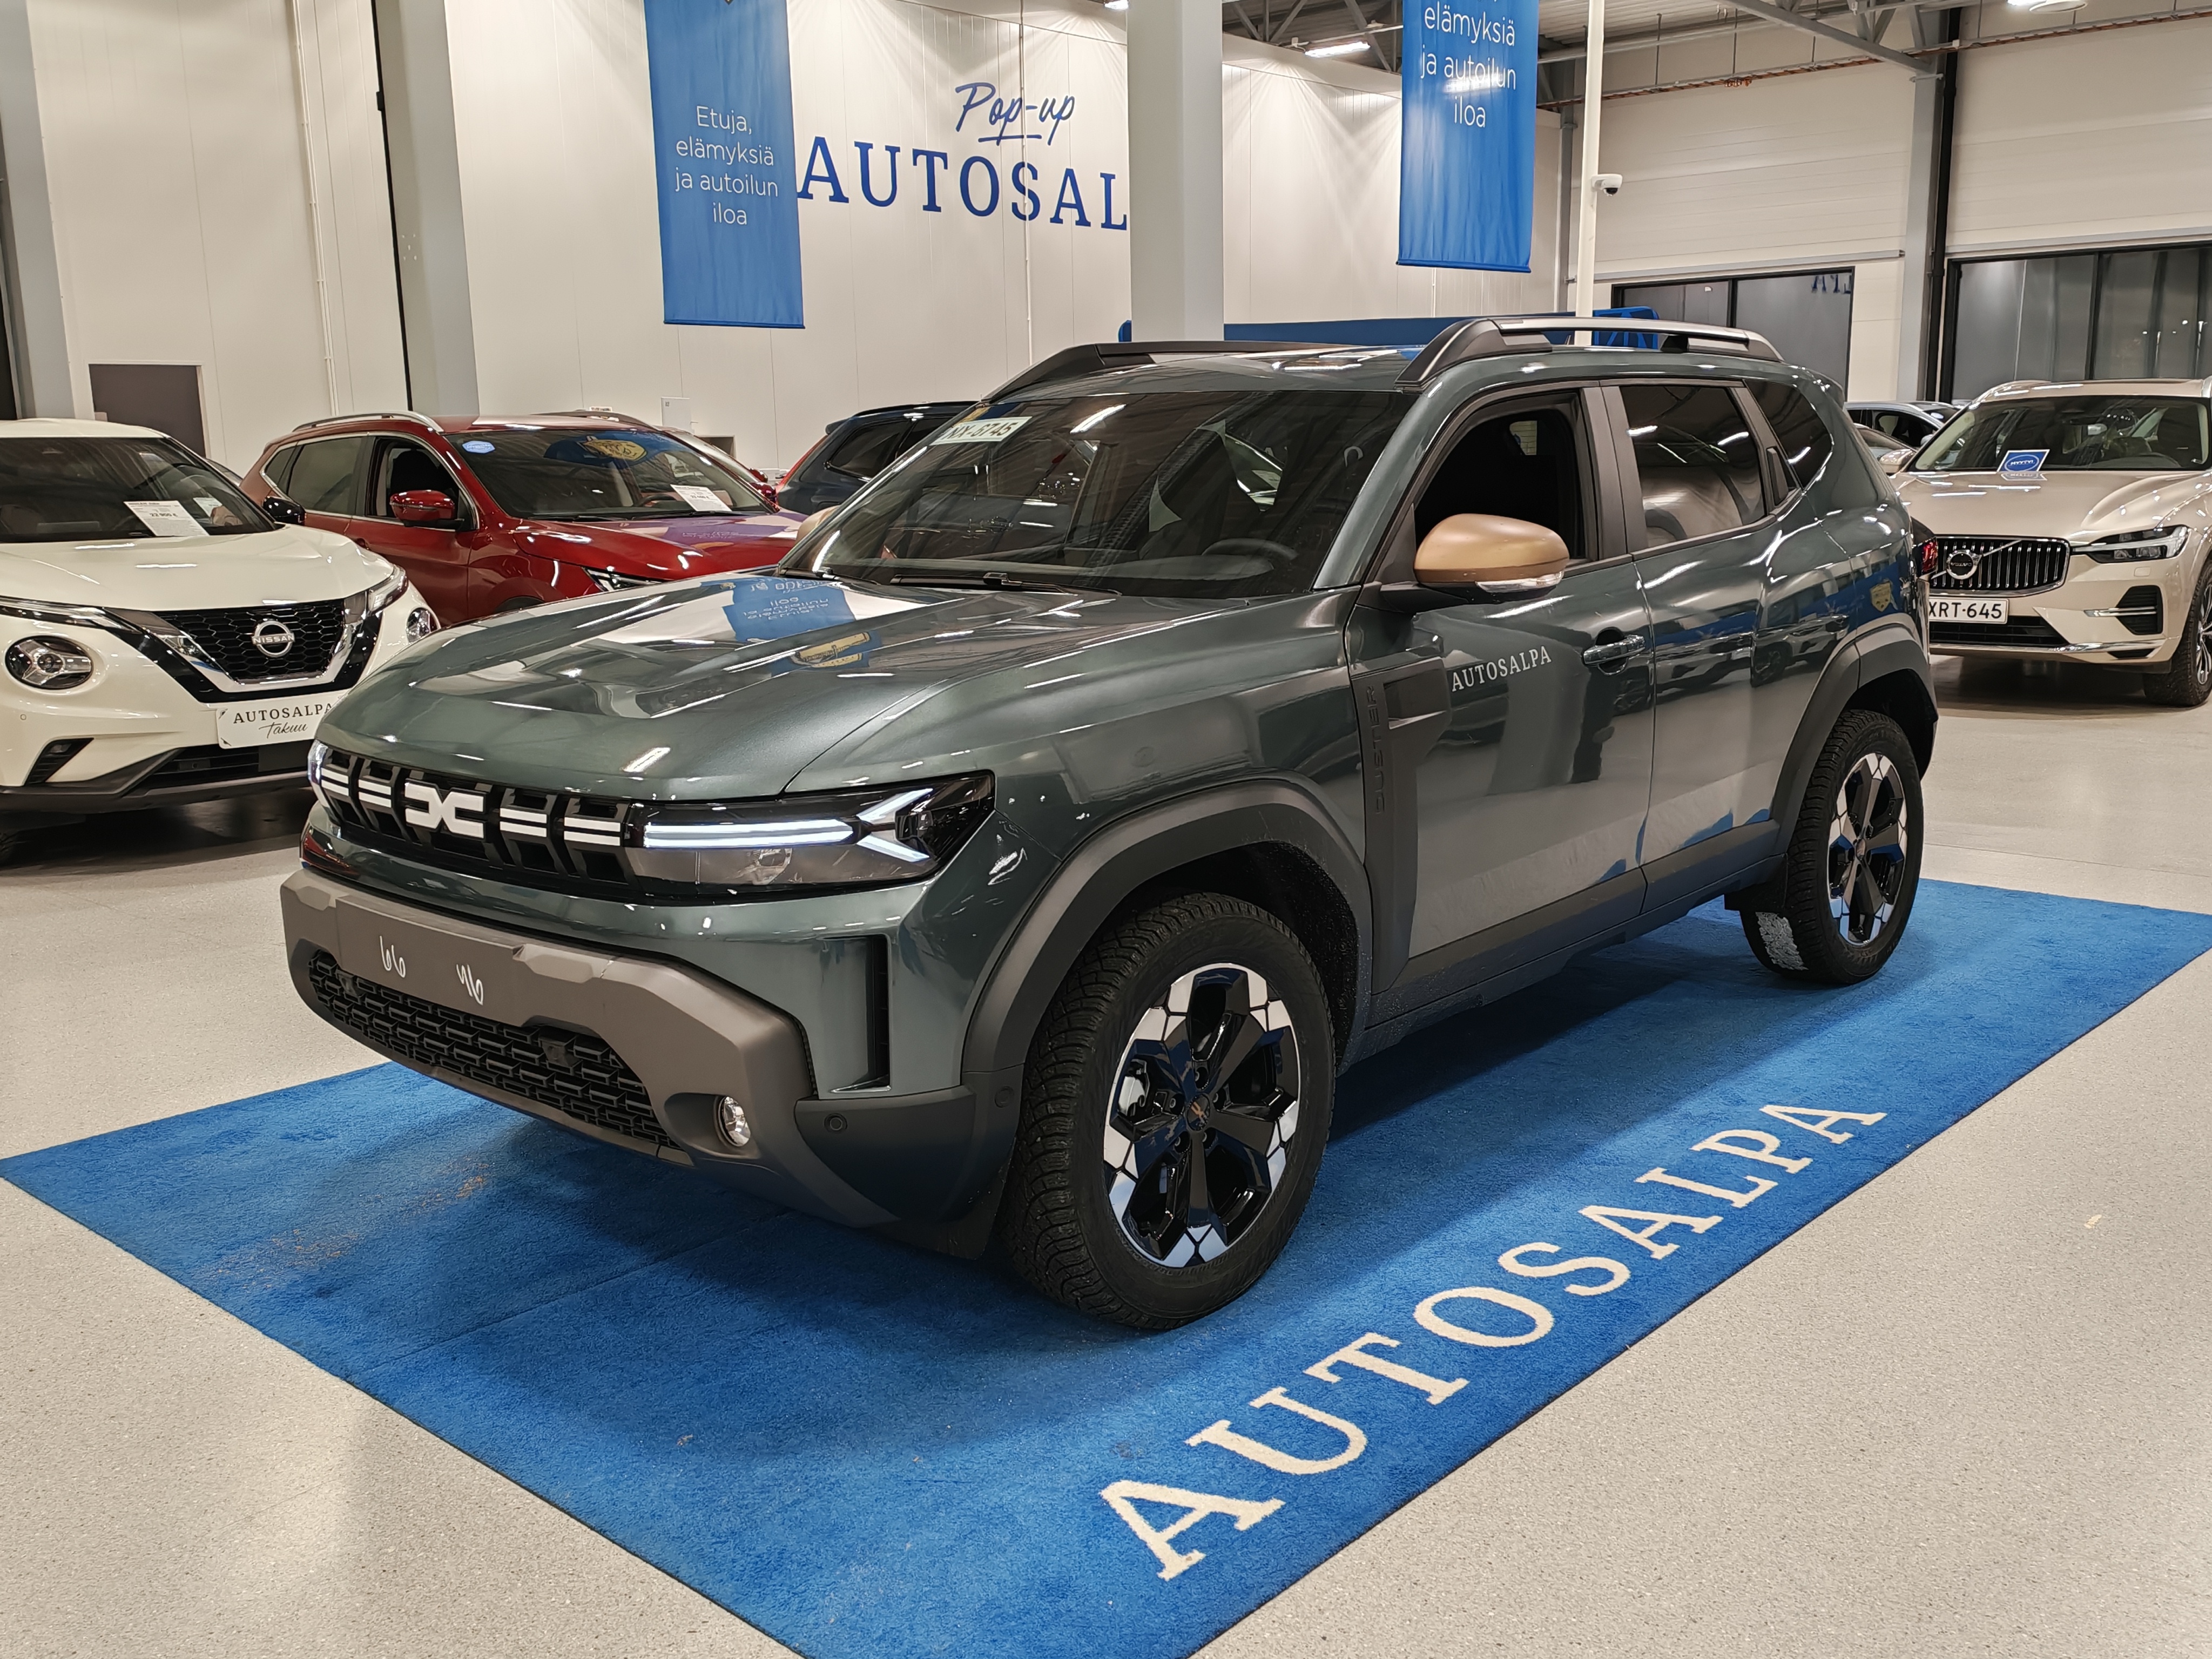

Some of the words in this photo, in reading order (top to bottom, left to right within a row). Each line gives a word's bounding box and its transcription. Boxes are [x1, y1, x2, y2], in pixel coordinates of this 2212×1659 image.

[1425, 1, 1515, 46] elämyksiä
[1420, 45, 1437, 79] ja
[1444, 55, 1516, 90] autoilun
[697, 105, 752, 135] Etuja,
[955, 82, 1075, 146] Pop-up
[1454, 96, 1486, 128] iloa
[676, 136, 774, 166] elämyksiä
[675, 167, 693, 192] ja
[700, 173, 778, 197] autoilun
[713, 202, 747, 225] iloa
[1929, 602, 2002, 619] XRT-645
[253, 635, 294, 643] NISSAN
[1452, 645, 1552, 692] AUTOSALPA
[233, 703, 332, 724] AUTOSALPA
[258, 721, 308, 739] Takuu
[1366, 685, 1385, 814] DUSTER
[1098, 1103, 1889, 1582] AUTOSALPA
